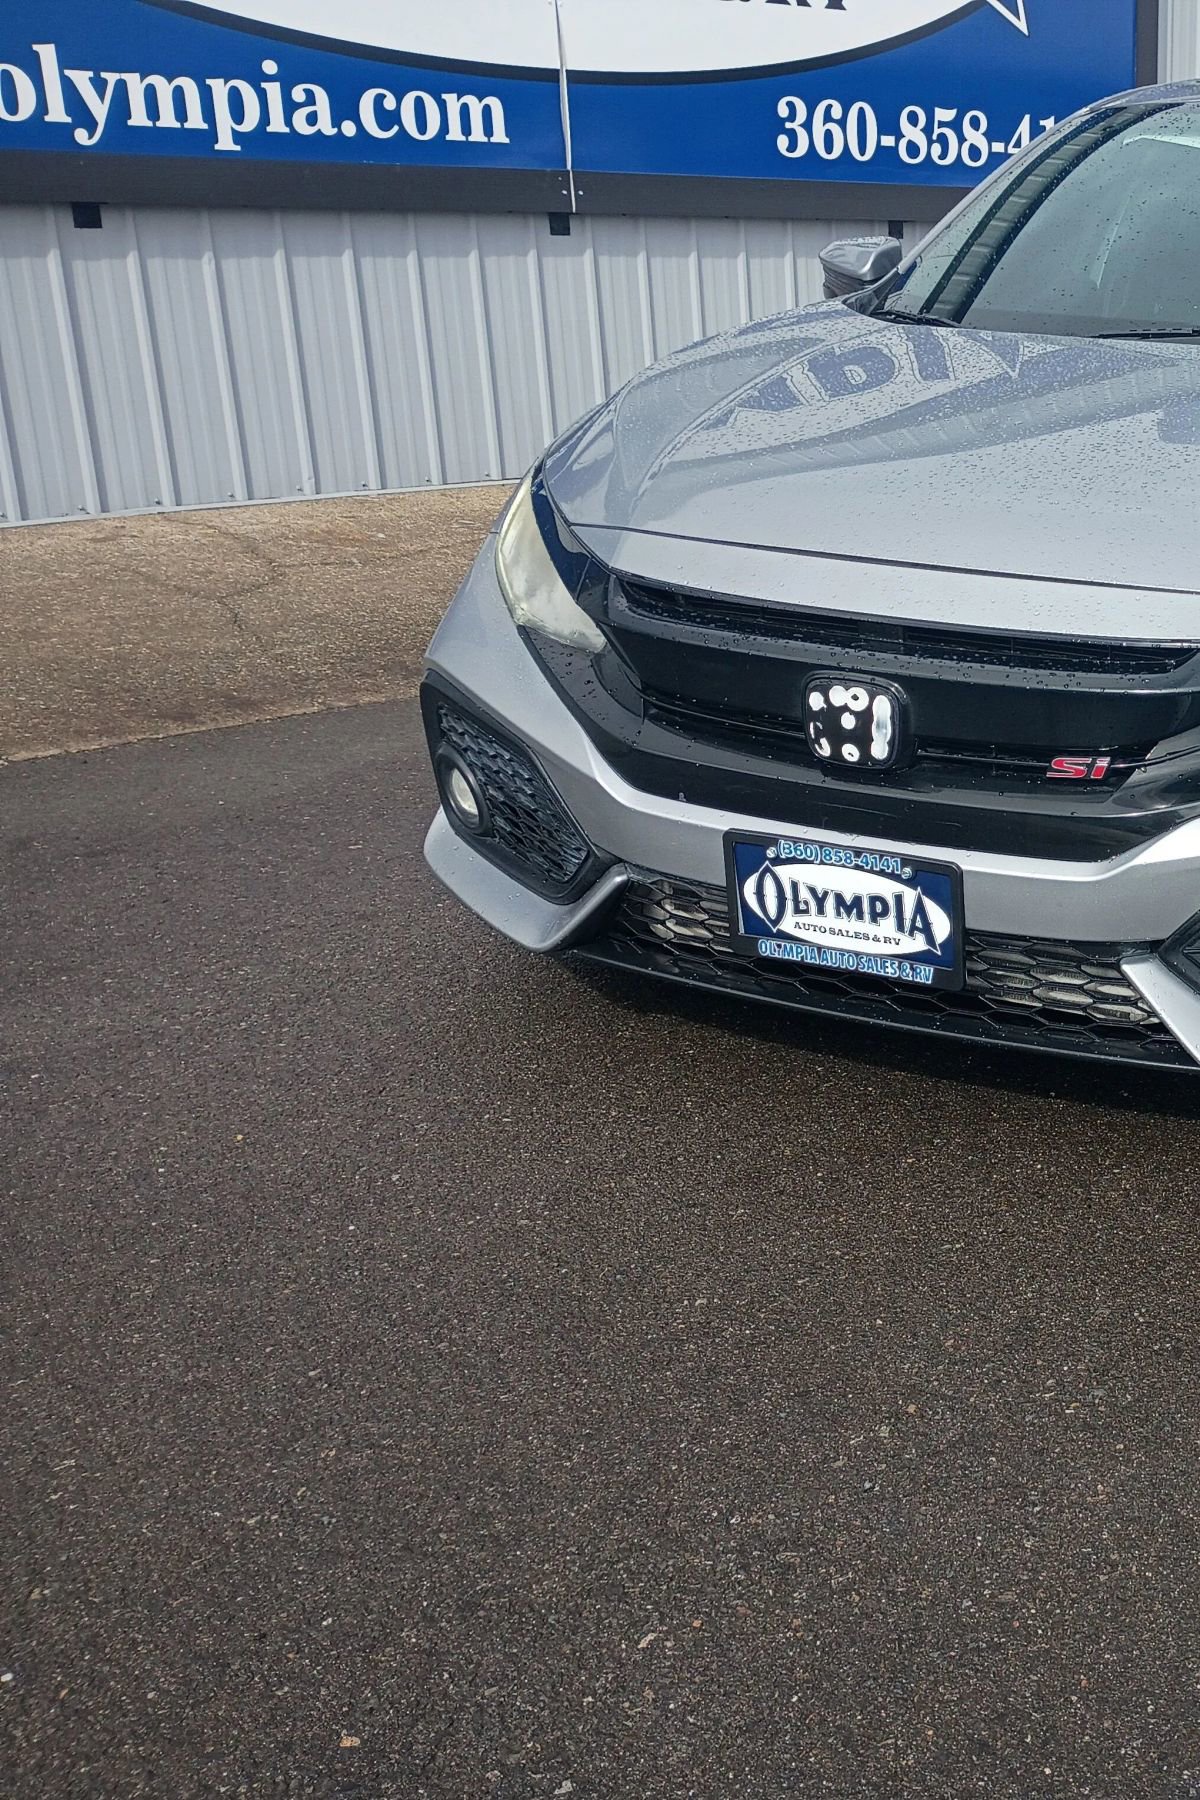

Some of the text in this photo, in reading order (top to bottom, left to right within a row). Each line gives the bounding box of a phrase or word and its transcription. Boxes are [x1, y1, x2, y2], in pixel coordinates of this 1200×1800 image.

[1046, 756, 1111, 779] Si
[778, 840, 902, 874] (360) 858-4141
[754, 860, 941, 956] OLYMPIA
[794, 921, 901, 946] AUTO SALES & RV
[758, 939, 934, 984] OLYMPIA AUTO SALES & RV
